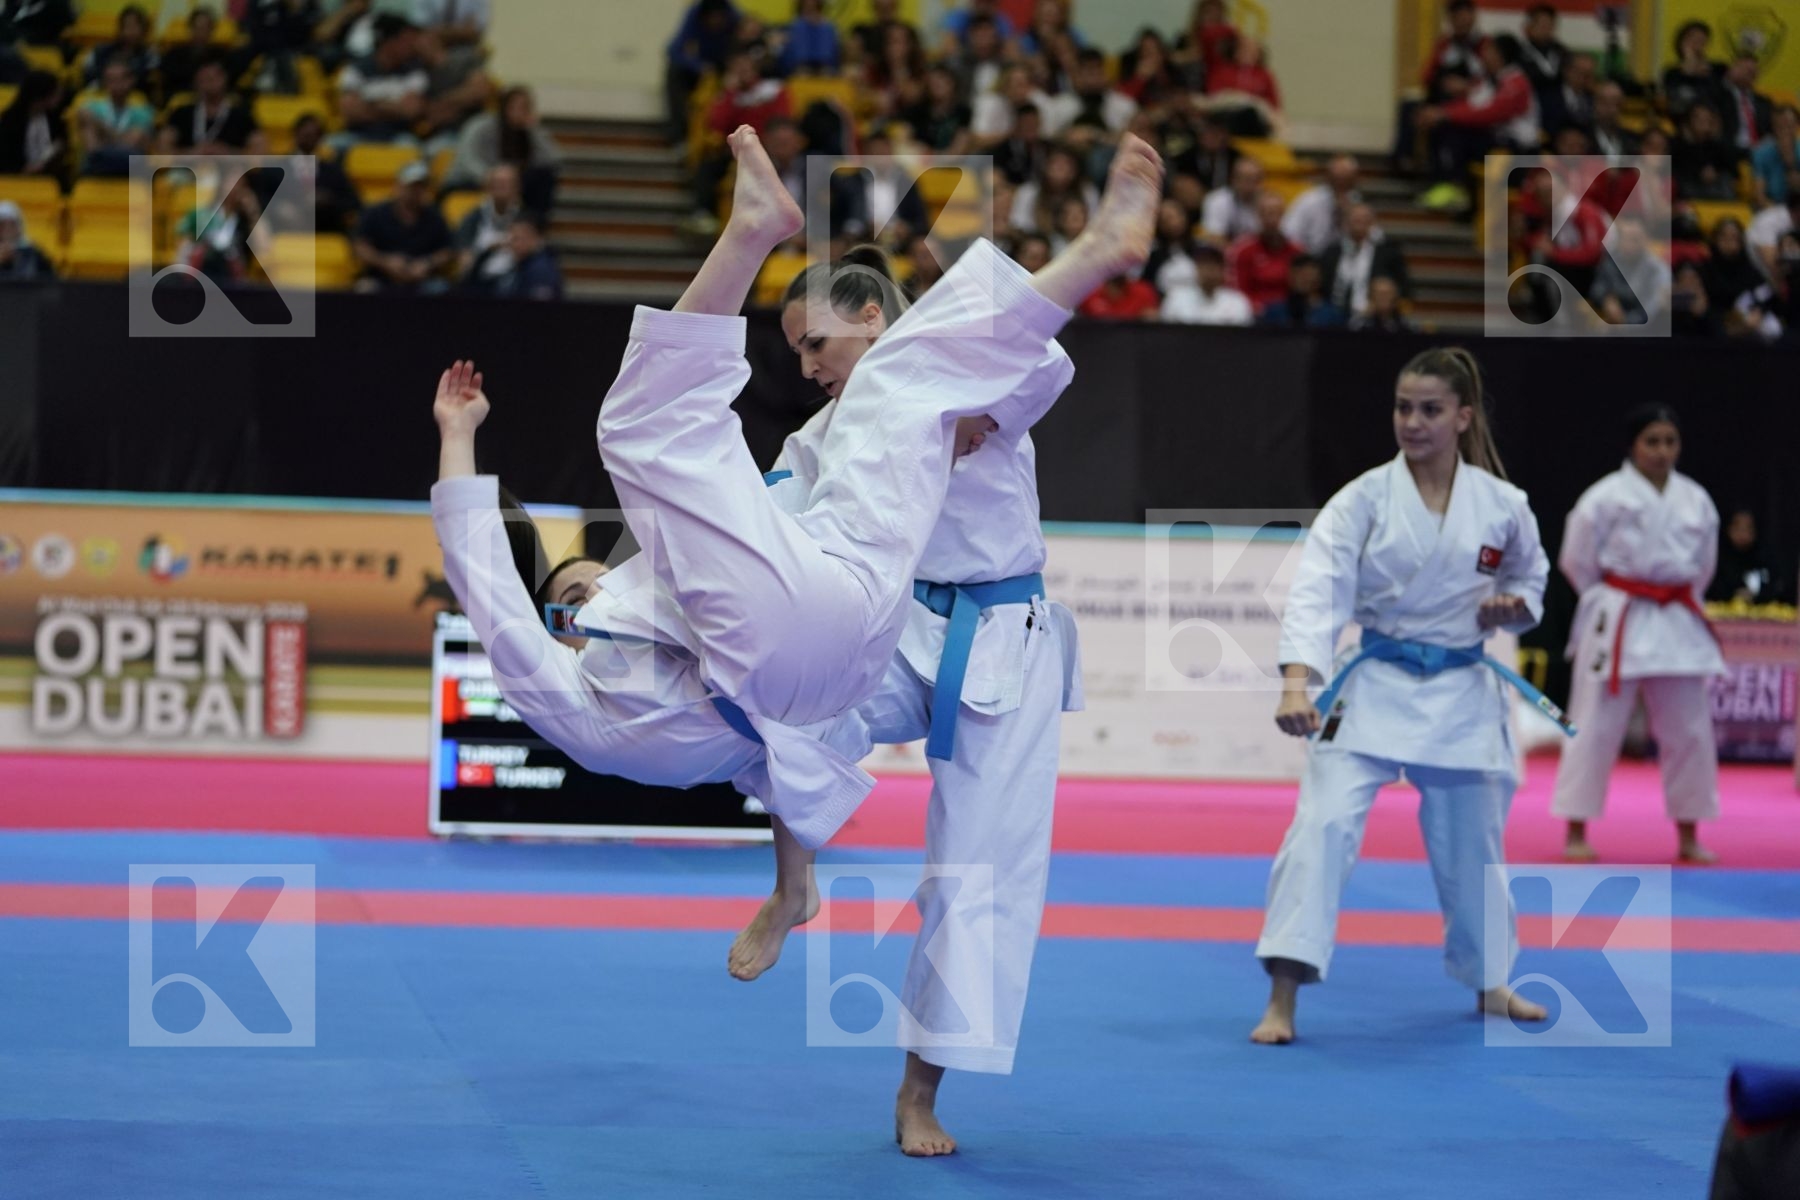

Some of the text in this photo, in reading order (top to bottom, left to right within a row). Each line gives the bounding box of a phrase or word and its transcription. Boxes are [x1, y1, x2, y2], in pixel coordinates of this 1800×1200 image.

[35, 614, 263, 679] OPEN
[32, 677, 262, 736] DUBAI
[459, 744, 529, 766] TURKEY
[494, 767, 566, 788] TURKEY
